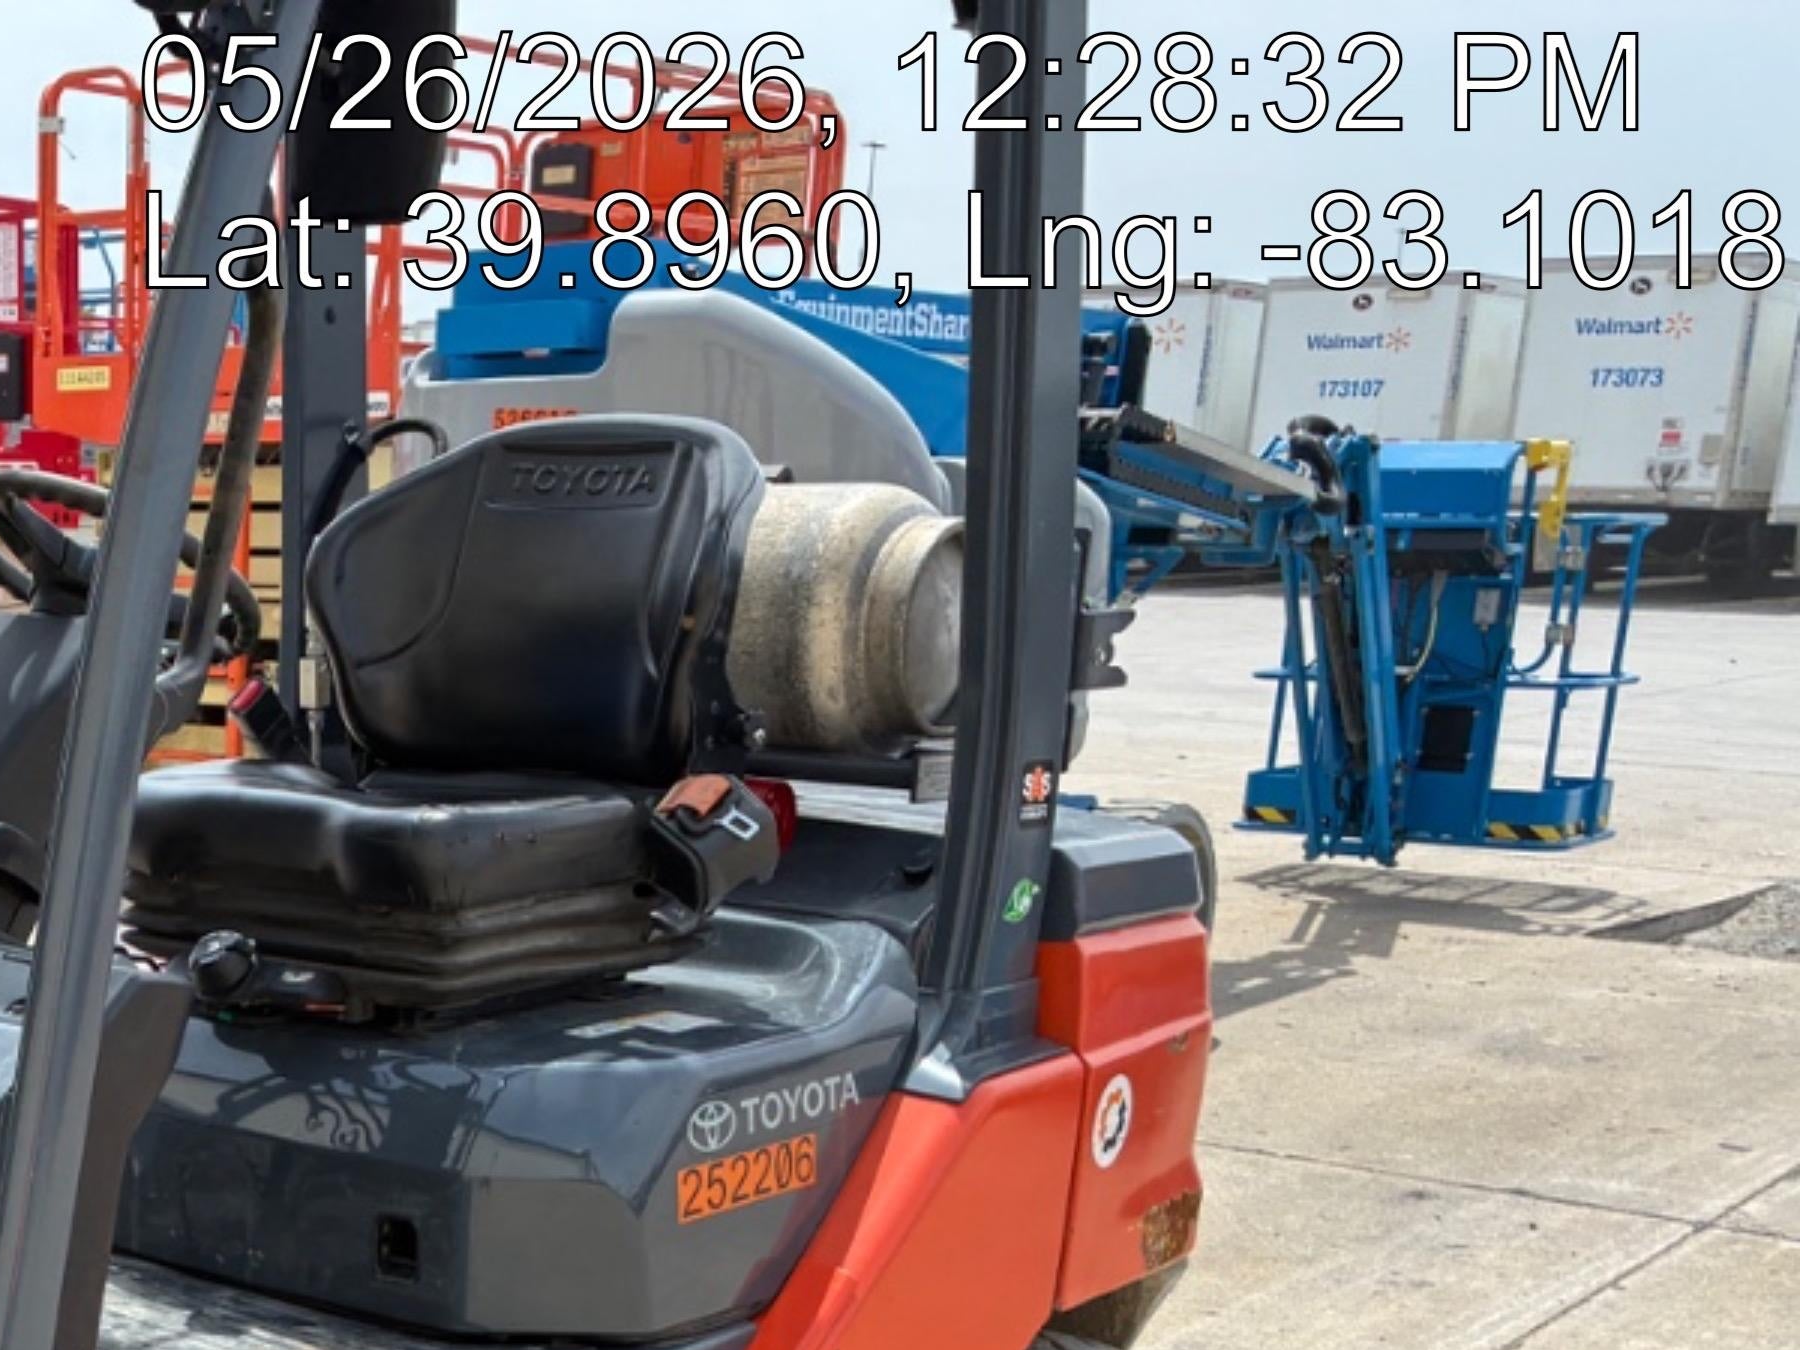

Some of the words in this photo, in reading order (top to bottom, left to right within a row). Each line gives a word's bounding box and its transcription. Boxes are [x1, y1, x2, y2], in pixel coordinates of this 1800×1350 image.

[1576, 315, 1661, 337] Walmart
[1306, 331, 1384, 352] Walmart
[1317, 378, 1385, 399] 173107
[1590, 367, 1664, 389] 173073
[511, 462, 654, 496] TOYOTA
[740, 1071, 860, 1135] TOYOTA
[681, 1136, 816, 1218] 252206
